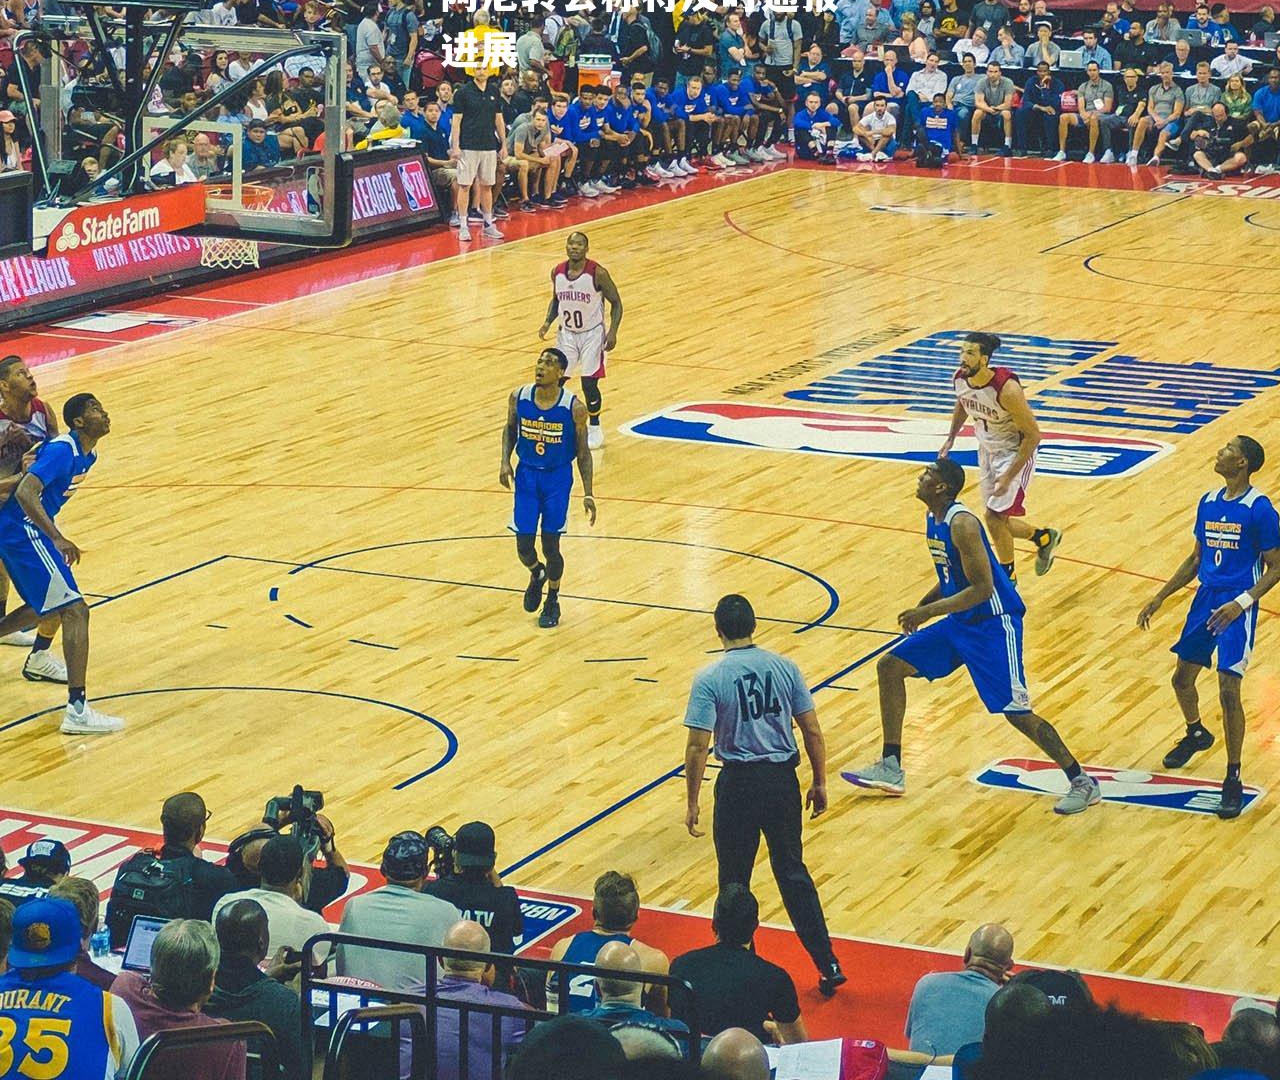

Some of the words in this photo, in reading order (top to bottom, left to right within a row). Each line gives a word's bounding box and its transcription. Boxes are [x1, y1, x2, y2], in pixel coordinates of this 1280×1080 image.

[356, 171, 402, 218] LEAGUE
[411, 170, 428, 199] TV
[91, 241, 130, 271] MGM
[20, 256, 76, 297] LEAGUE
[563, 310, 584, 329] 20
[535, 442, 545, 456] 6
[1214, 549, 1223, 567] 0
[733, 670, 783, 723] 134
[475, 911, 495, 928] TV
